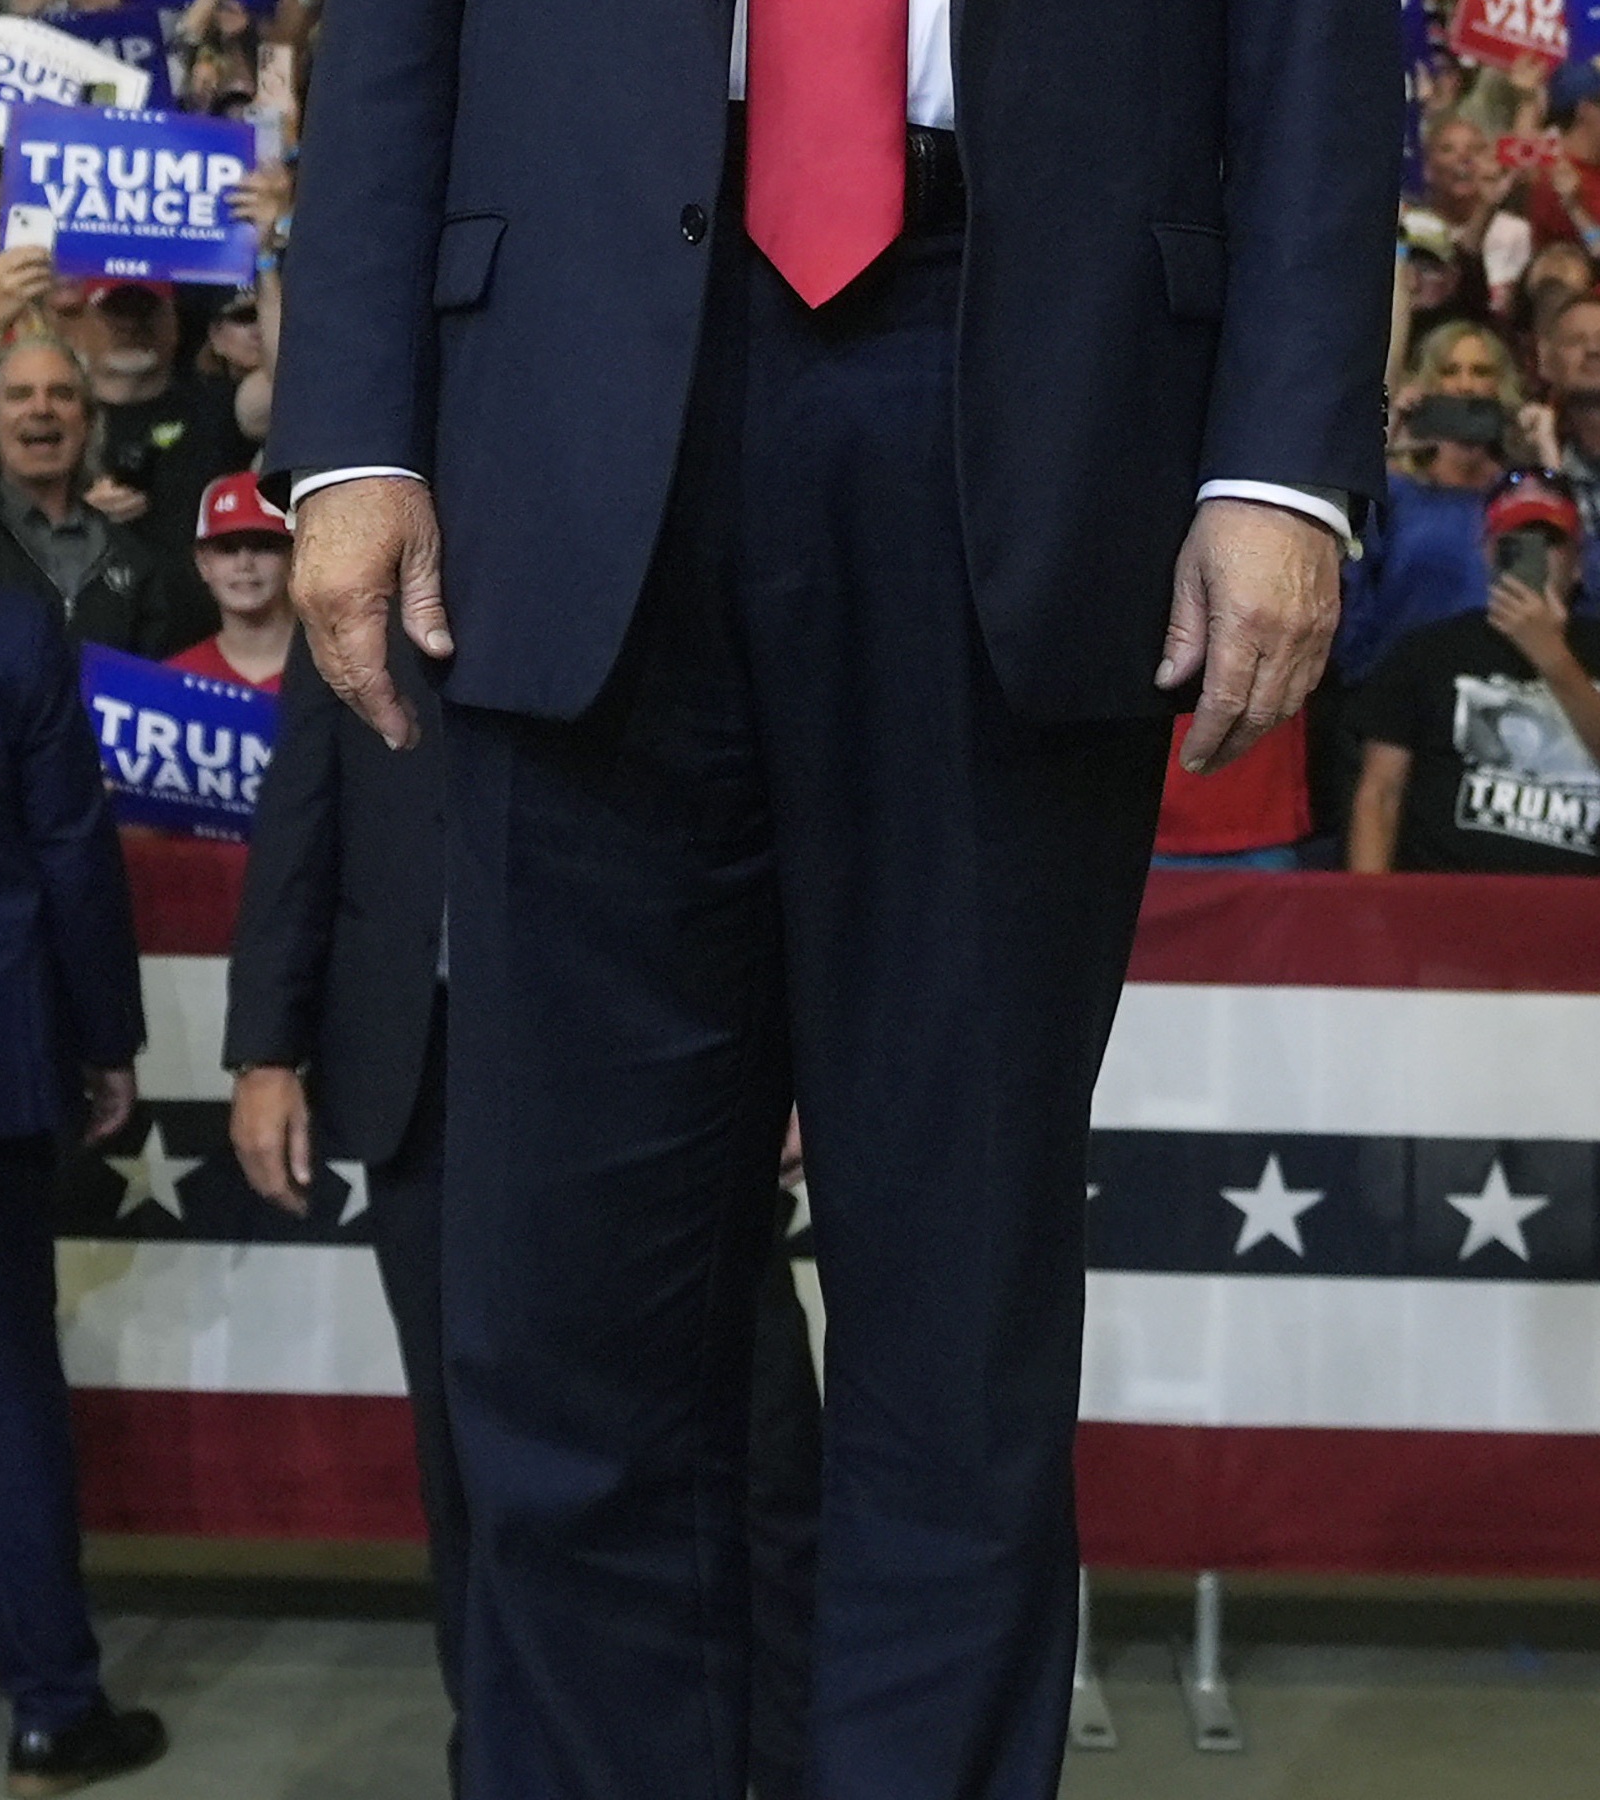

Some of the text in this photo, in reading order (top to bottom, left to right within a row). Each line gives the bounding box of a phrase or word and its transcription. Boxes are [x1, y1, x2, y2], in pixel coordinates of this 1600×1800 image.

[20, 140, 243, 194] TRUMP
[43, 183, 217, 227] VANCE
[114, 746, 263, 804] VANC
